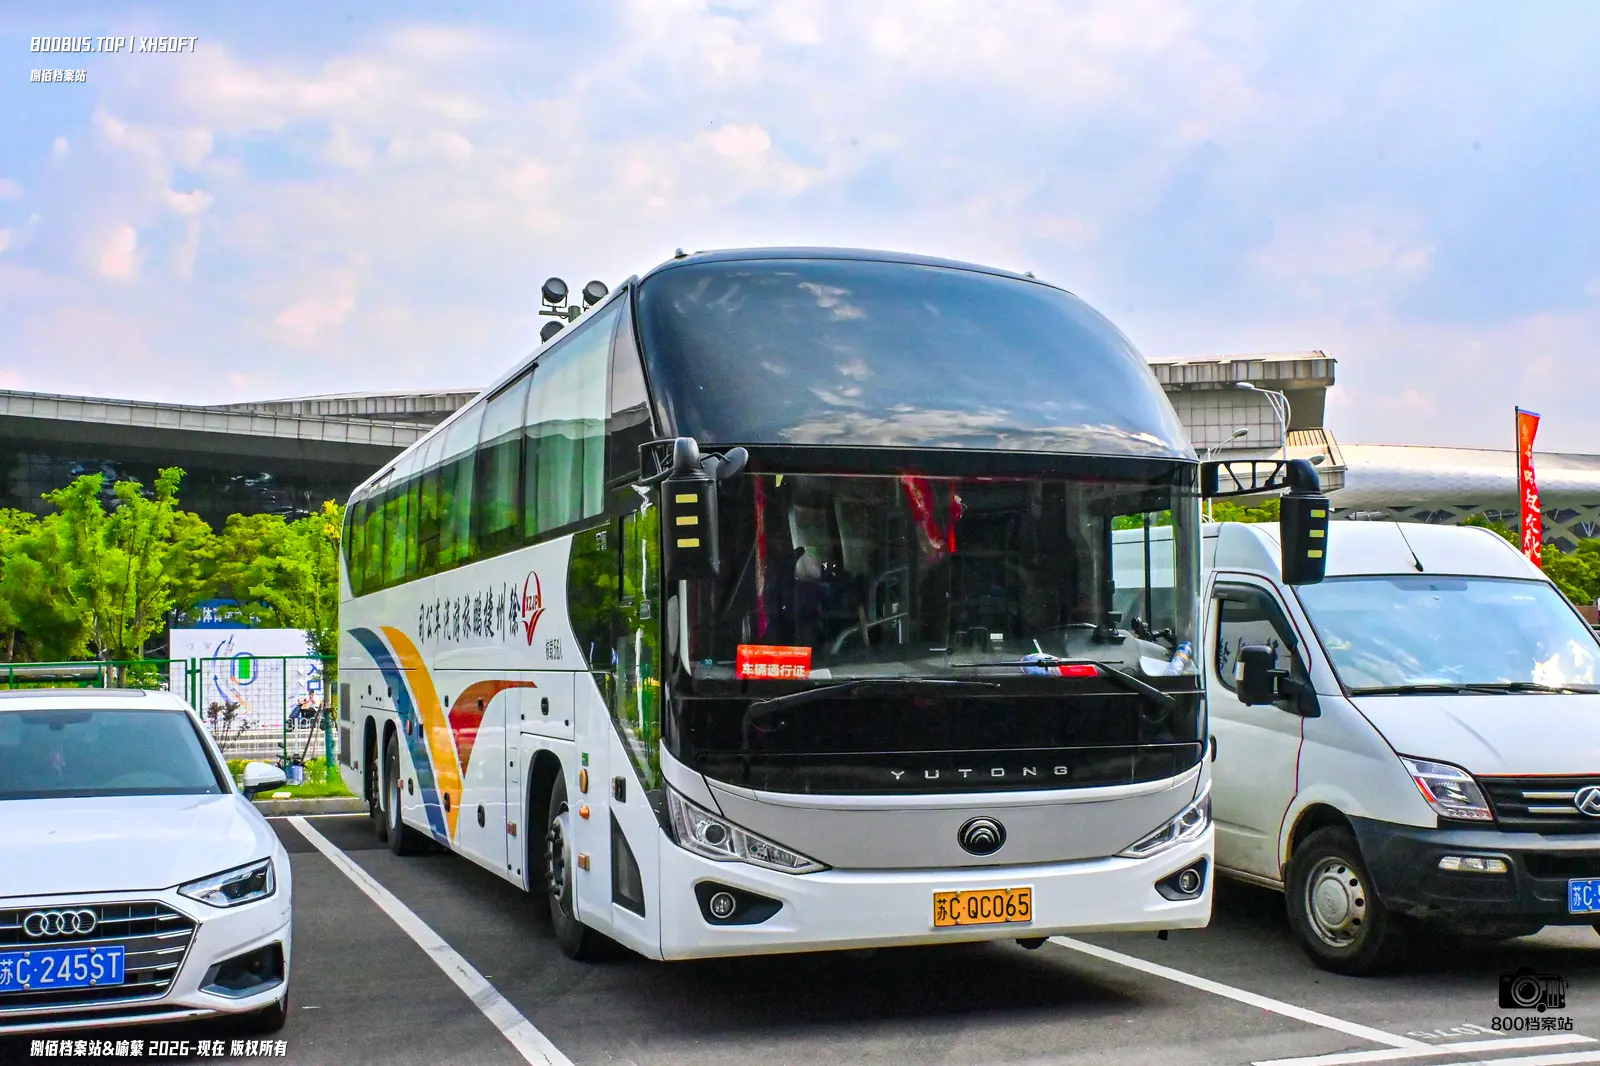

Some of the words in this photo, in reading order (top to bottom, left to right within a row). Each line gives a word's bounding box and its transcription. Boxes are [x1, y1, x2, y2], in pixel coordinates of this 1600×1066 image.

[742, 663, 806, 677] 车辆通行证
[890, 765, 1068, 780] YUTONG
